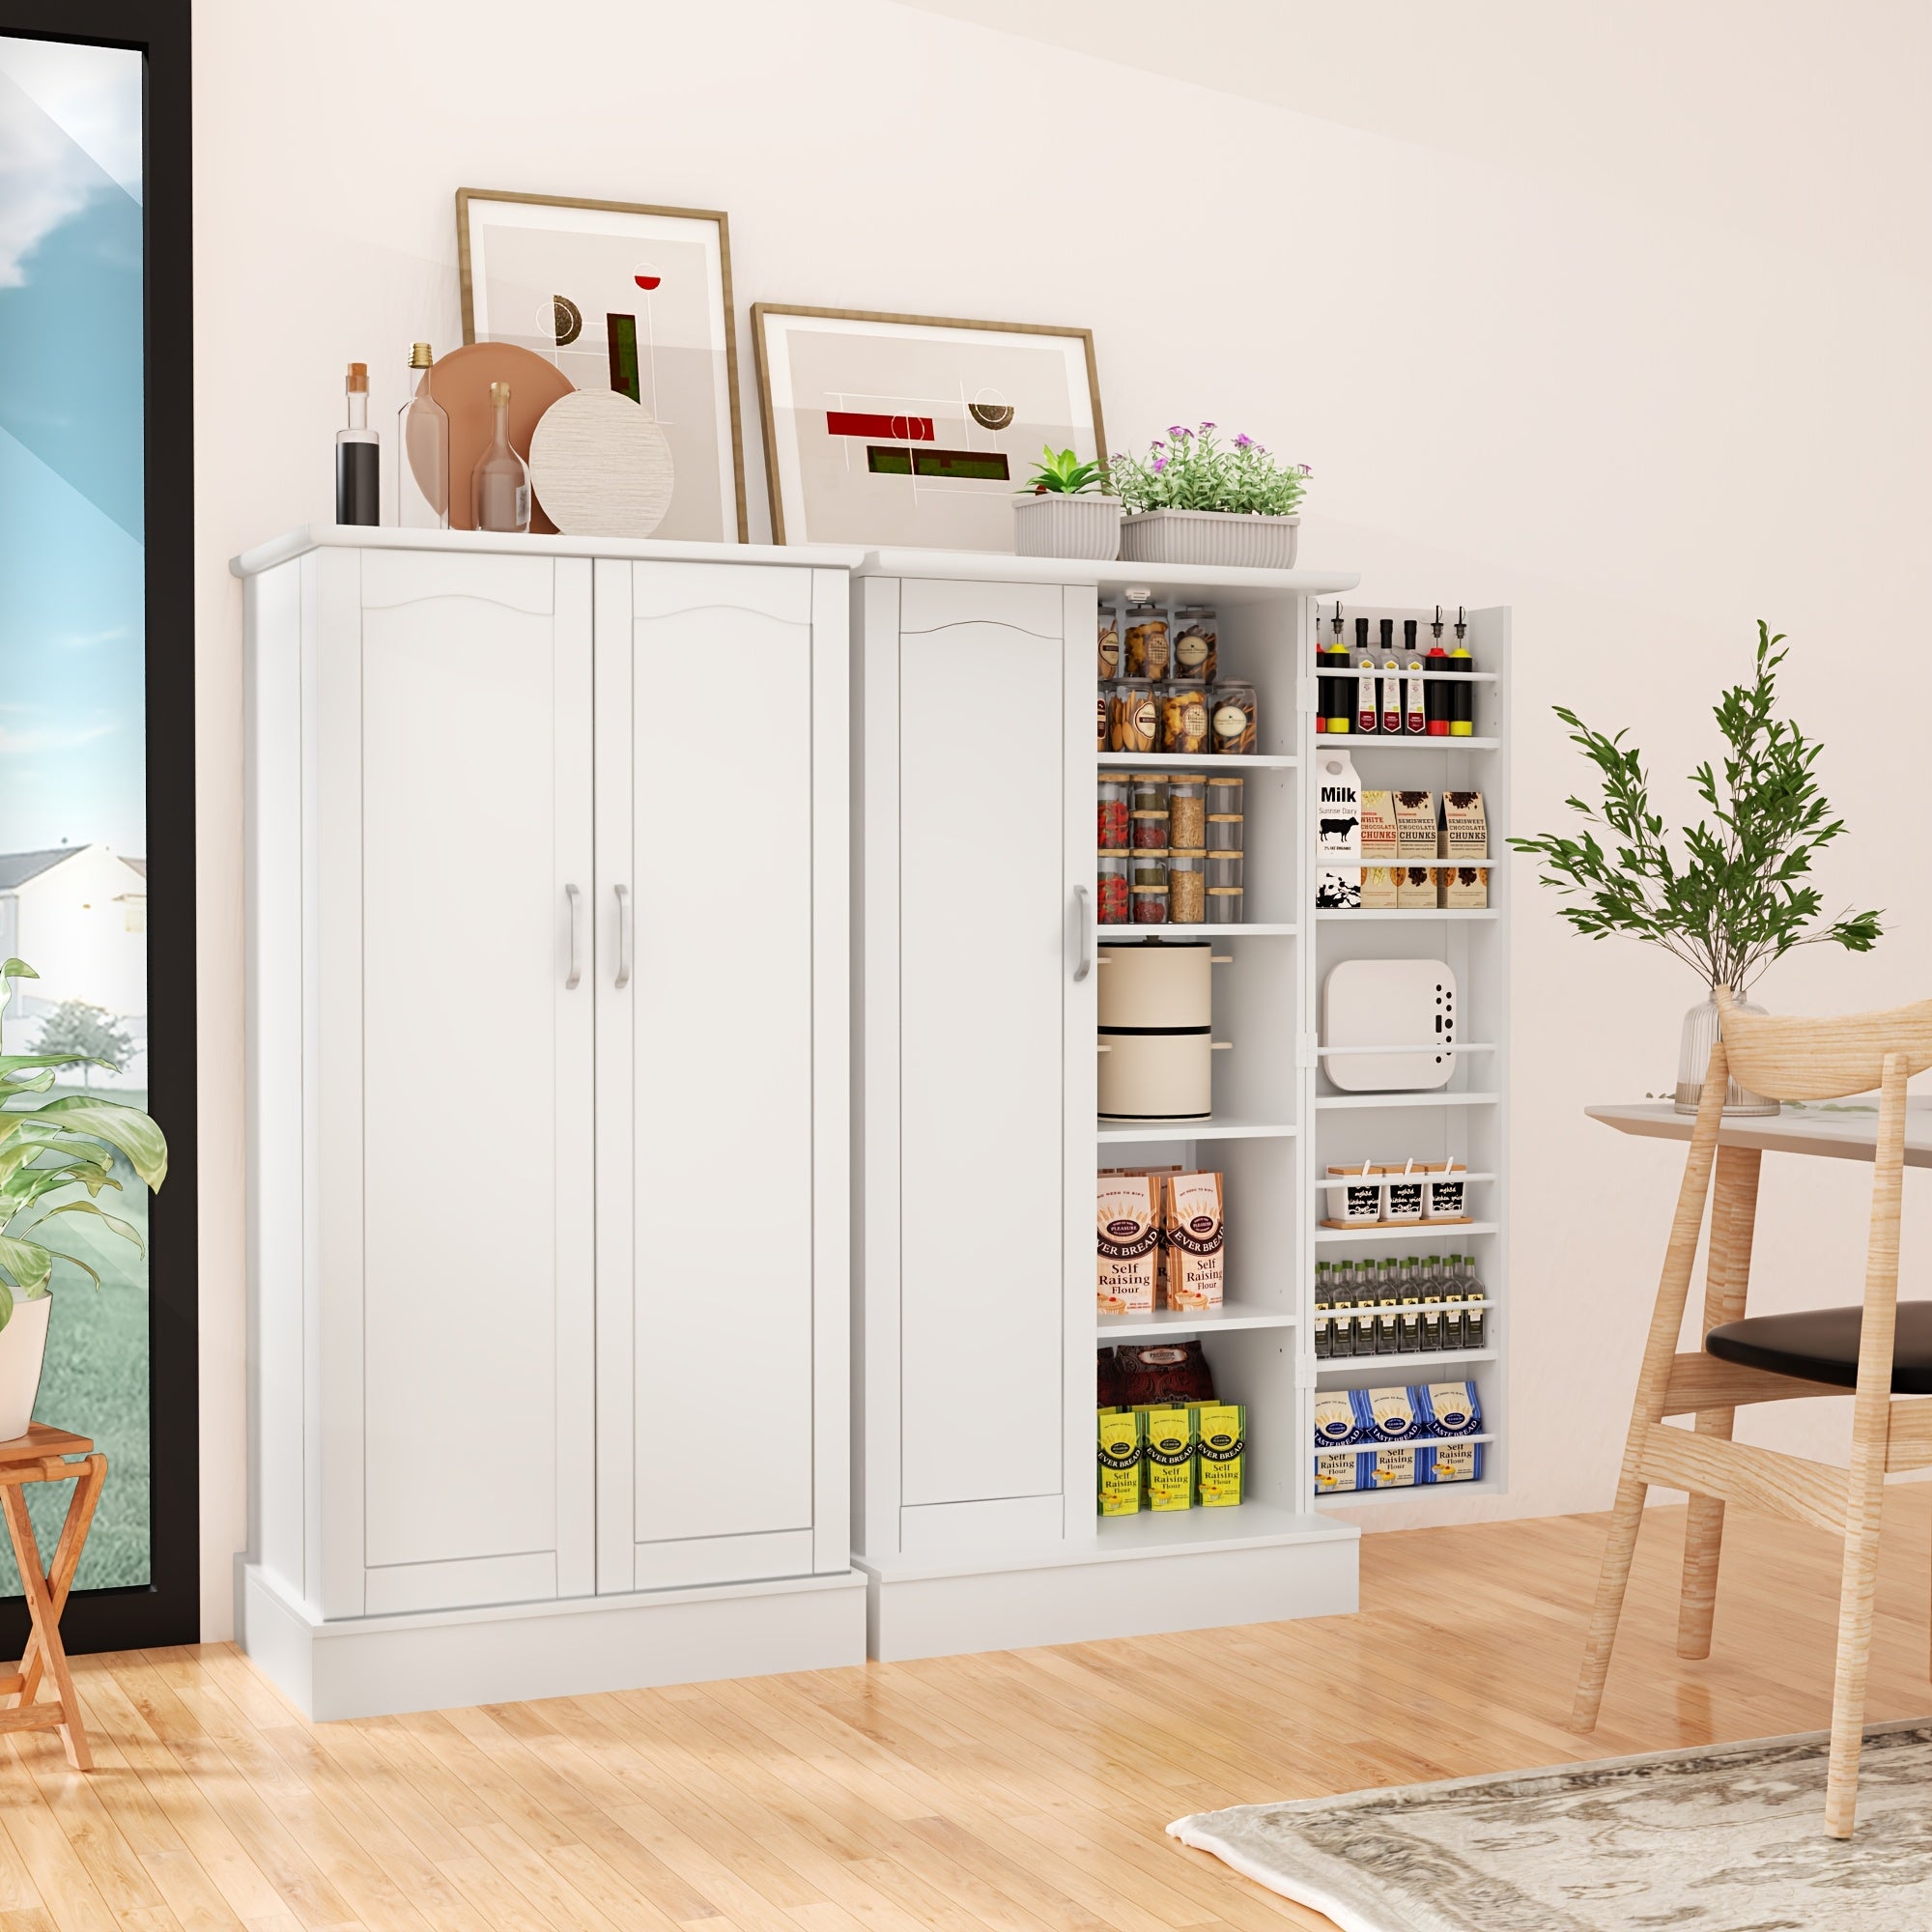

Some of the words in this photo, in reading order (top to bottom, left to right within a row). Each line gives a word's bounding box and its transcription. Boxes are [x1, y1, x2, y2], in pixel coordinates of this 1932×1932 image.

[1321, 787, 1356, 802] Milk
[1122, 1231, 1157, 1256] BREAD
[1175, 1231, 1201, 1251] EVER
[1112, 1263, 1139, 1274] Self
[1197, 1258, 1216, 1270] Self
[1099, 1275, 1150, 1286] Raising
[1187, 1270, 1222, 1282] Raising
[1147, 1448, 1167, 1463] EVER
[1169, 1446, 1193, 1464] BREAD
[1198, 1443, 1217, 1459] EVER
[1220, 1442, 1243, 1459] BREAD
[1098, 1452, 1118, 1468] EVER
[1119, 1449, 1140, 1468] BREAD
[1380, 1456, 1413, 1464] Raising
[1321, 1461, 1355, 1469] Raising
[1106, 1480, 1137, 1488] Raising
